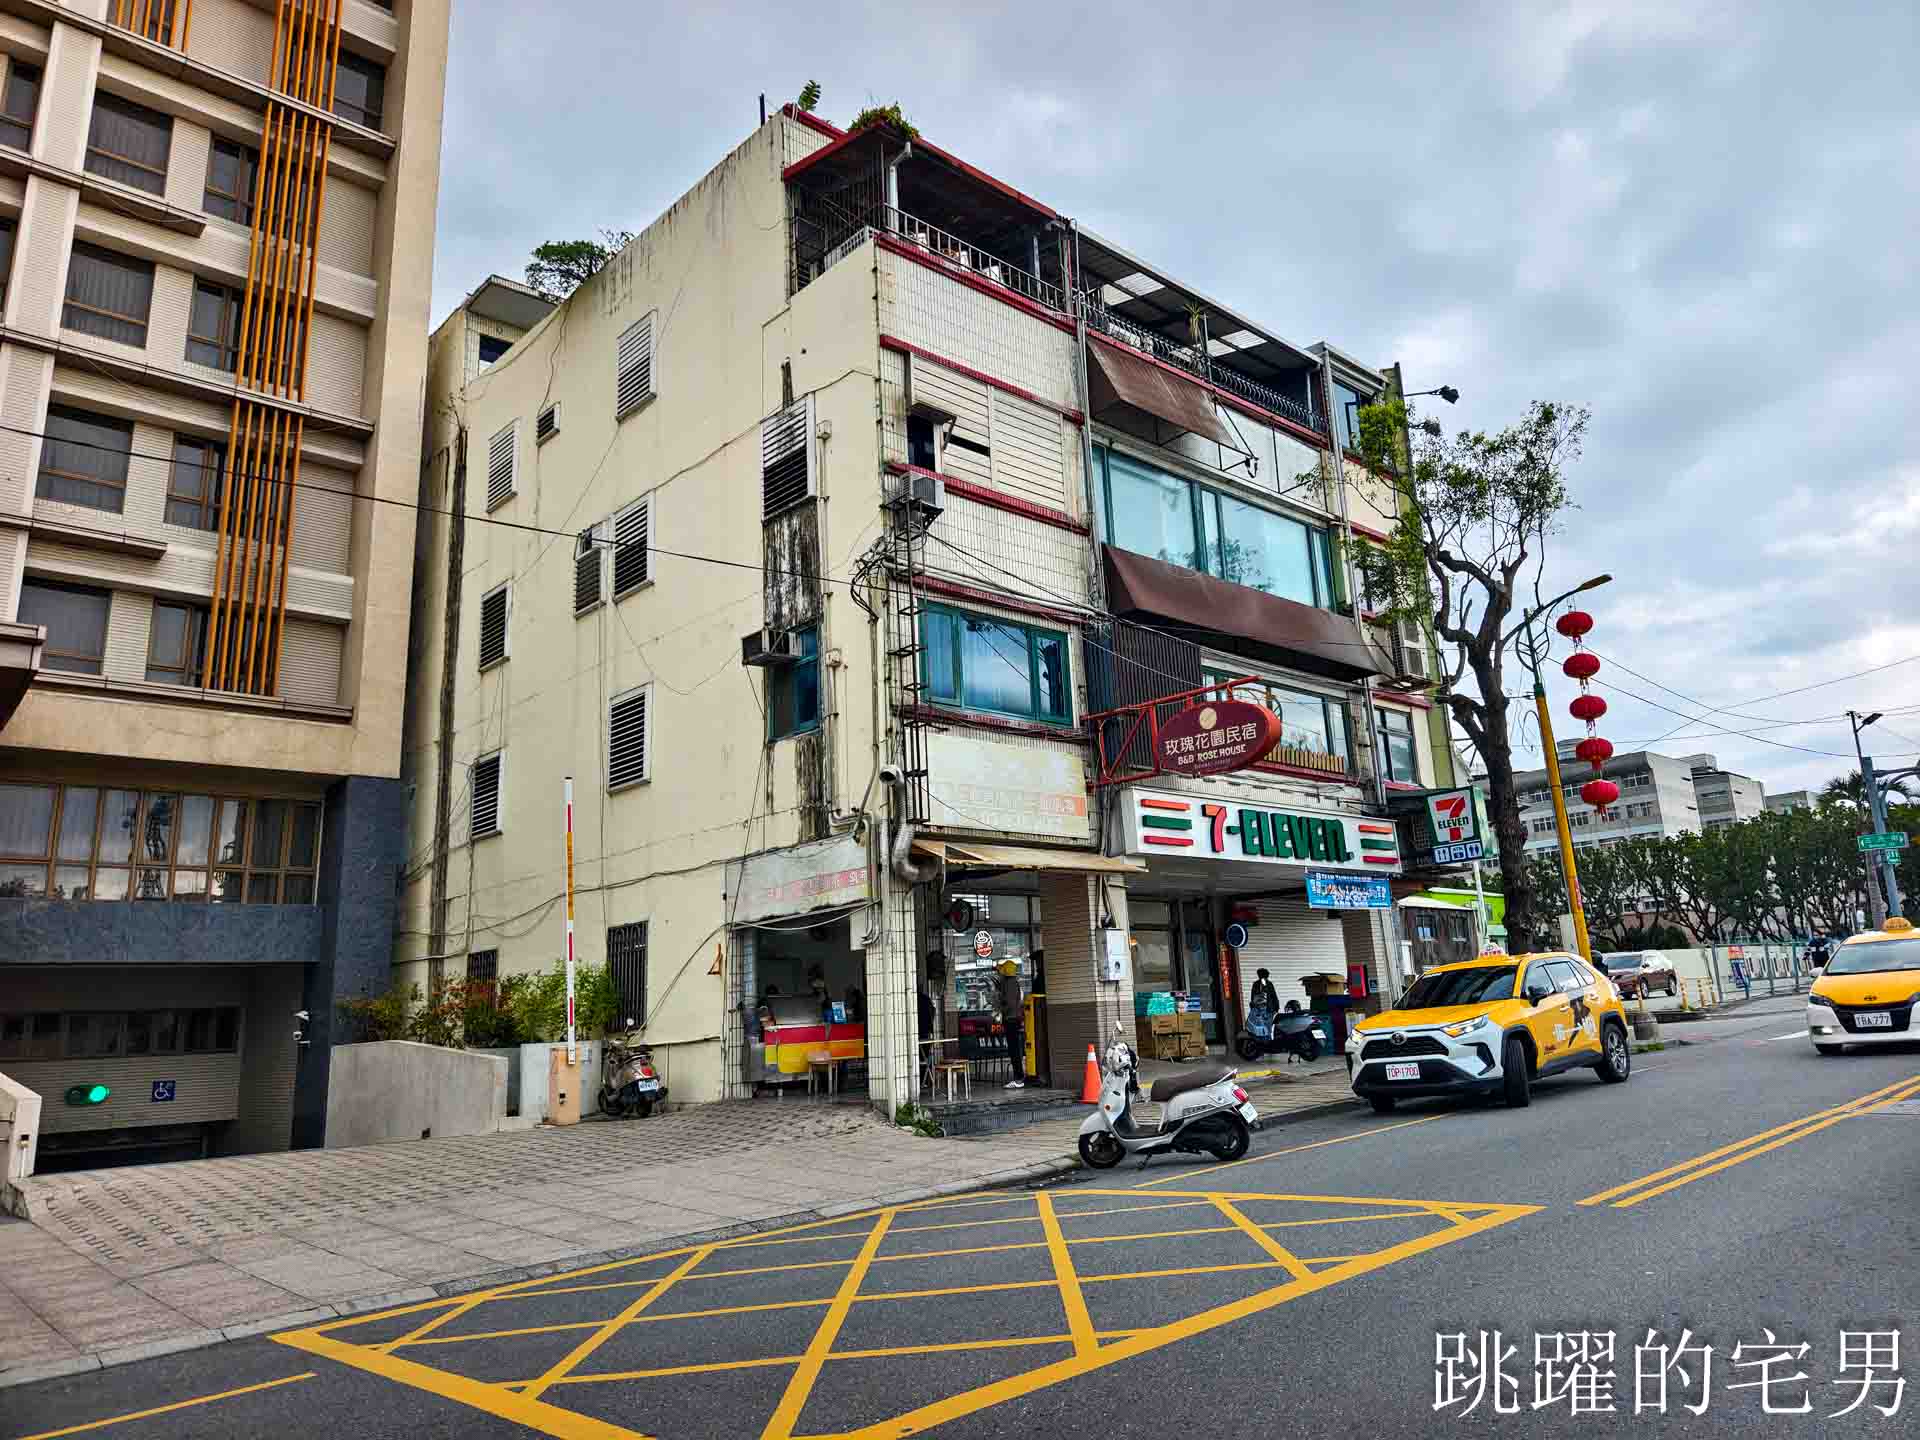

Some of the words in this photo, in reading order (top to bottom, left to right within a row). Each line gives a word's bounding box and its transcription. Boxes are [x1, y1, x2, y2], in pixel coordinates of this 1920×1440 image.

[1164, 722, 1257, 756] 玫瑰花園民宿
[1177, 754, 1195, 766] B&B
[1197, 748, 1219, 763] ROSE
[1219, 743, 1247, 758] HOUSE
